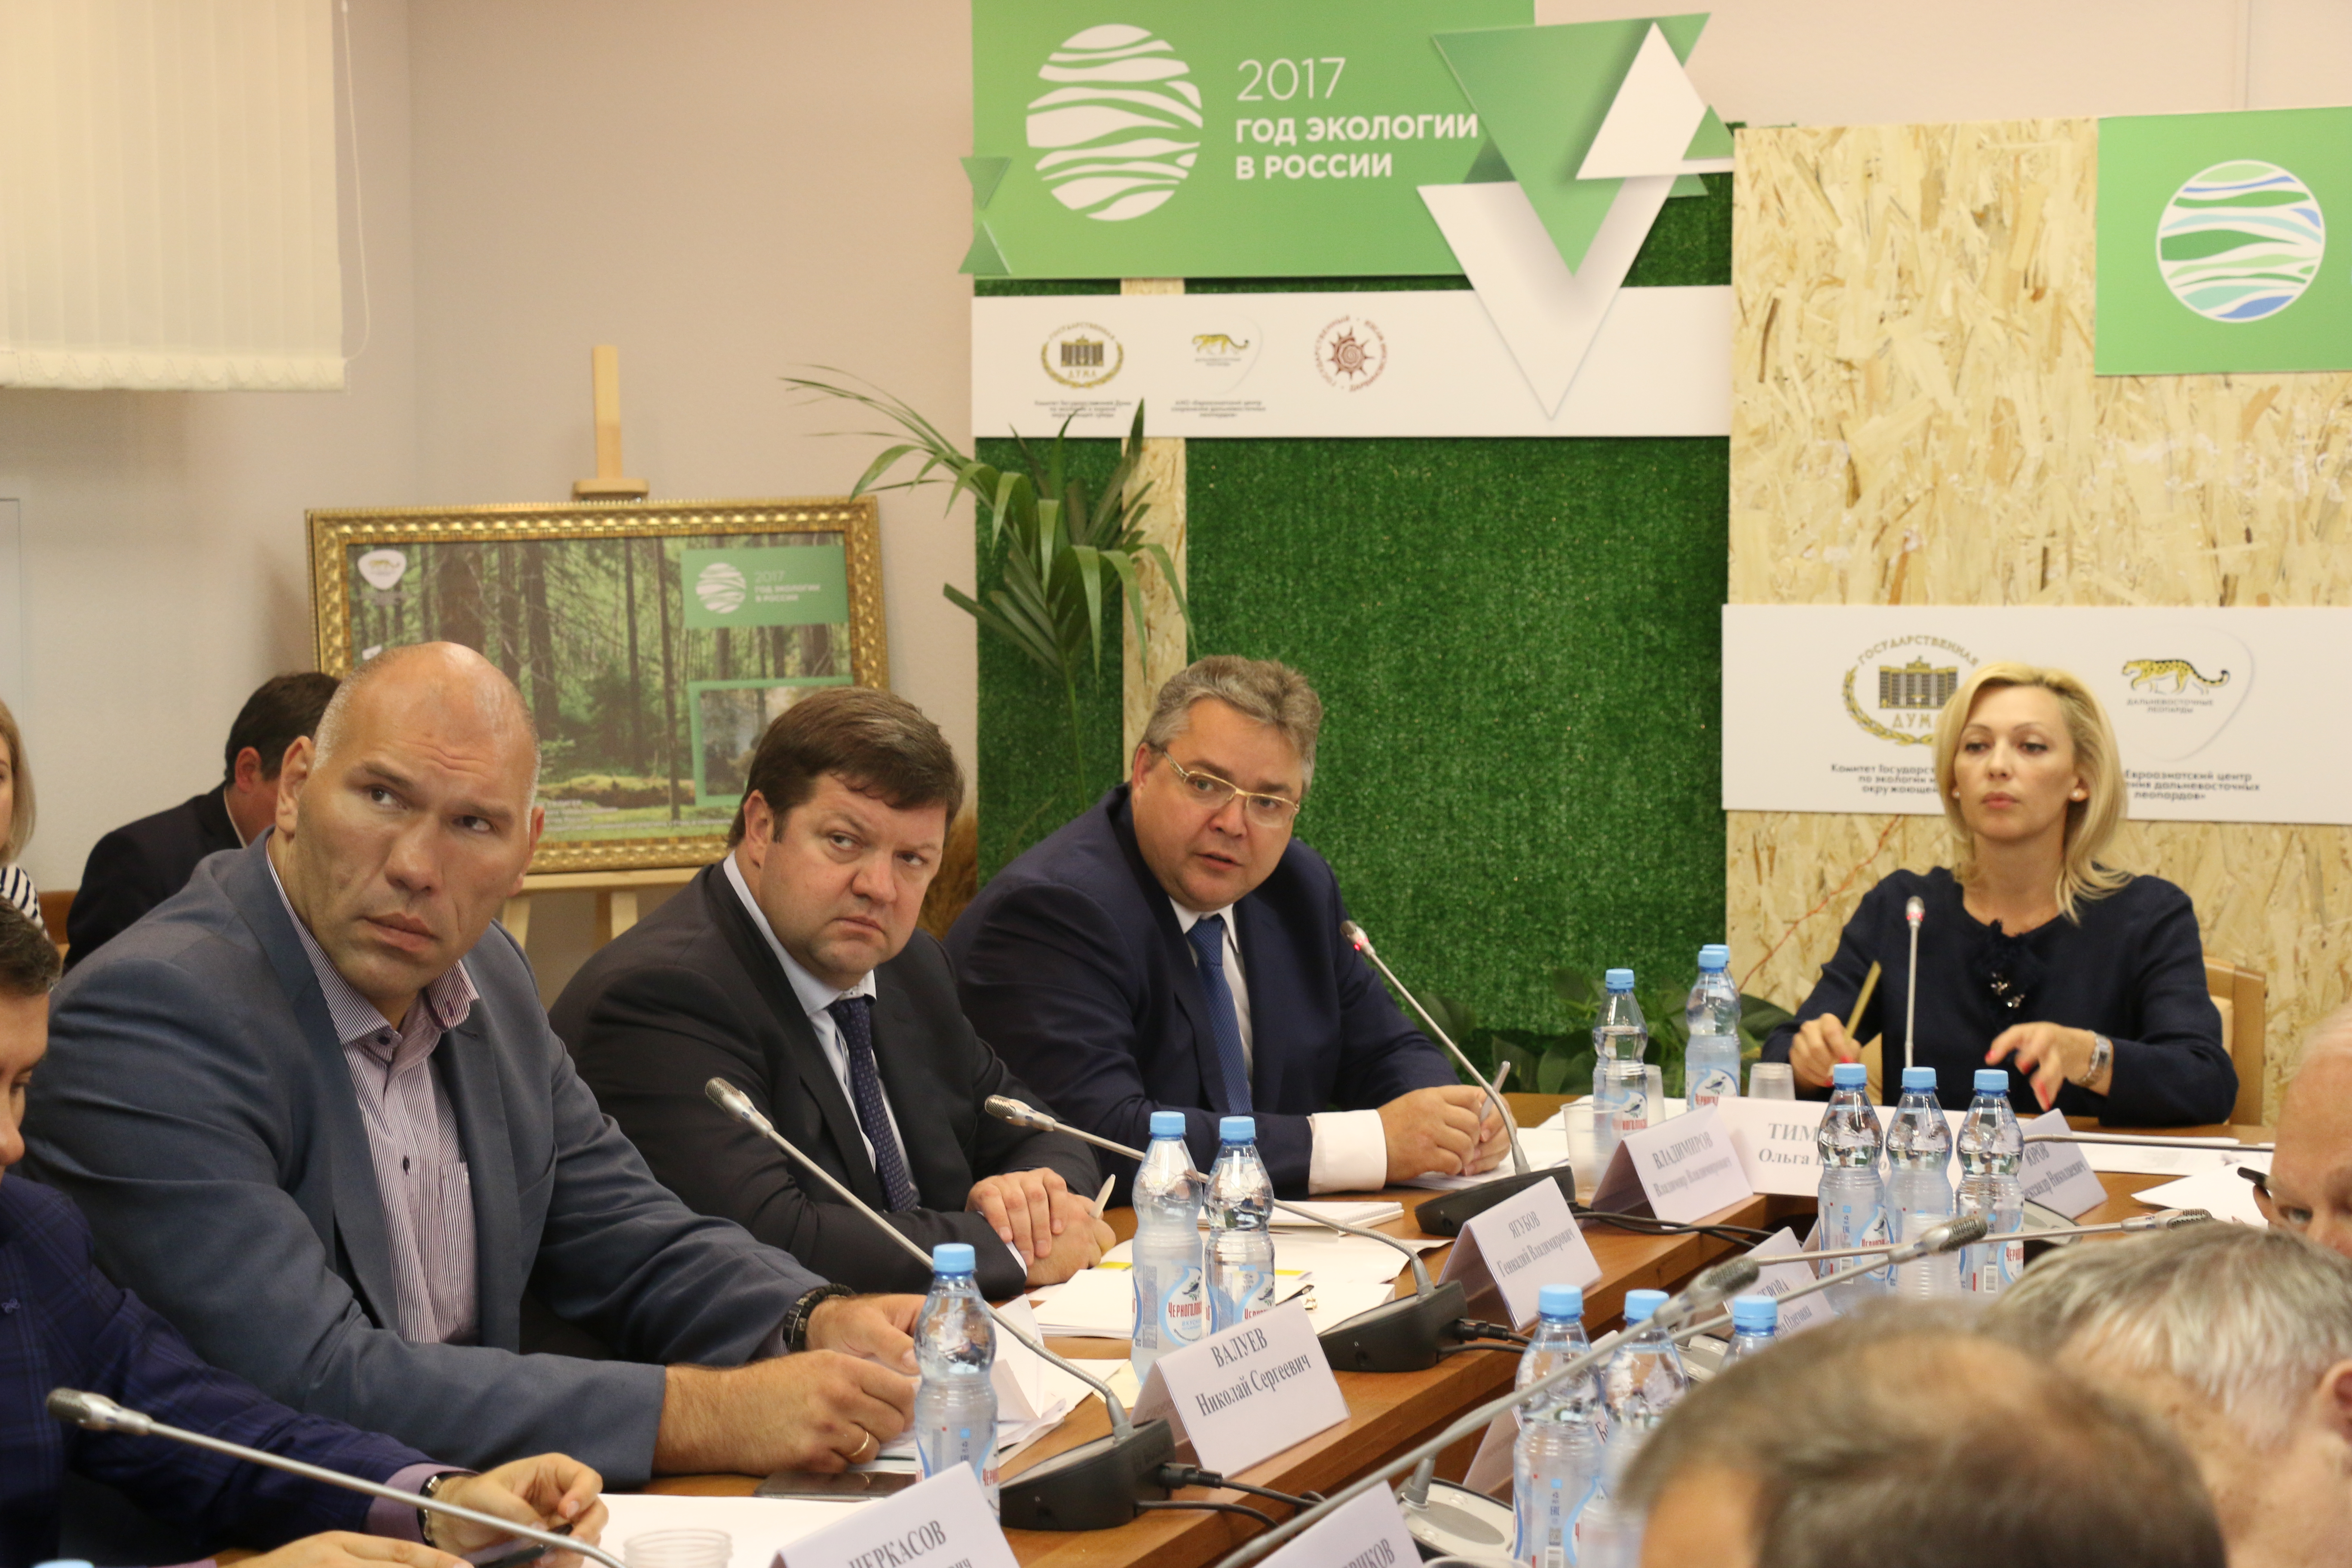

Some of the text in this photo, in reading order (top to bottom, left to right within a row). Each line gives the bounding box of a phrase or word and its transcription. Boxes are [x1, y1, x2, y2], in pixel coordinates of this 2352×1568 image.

[1237, 57, 1346, 101] 2017
[1236, 113, 1479, 146] ГОД ЭКОЛОГИИ
[1236, 153, 1393, 179] В РОССИИ
[1858, 634, 1979, 667] ГОСУДАРСТВЕННАЯ
[1893, 713, 1935, 729] ДУМ
[1831, 764, 1936, 777] Комитет Государст
[2217, 773, 2252, 782] центр
[2154, 782, 2260, 791] дальневосточных
[1768, 1123, 1820, 1142] ТИМ
[1652, 1131, 1714, 1170] ВЛАДИМИРОВ
[1758, 1148, 1810, 1165] Ольга
[1508, 1210, 1540, 1239] ЯГУБОВ
[1496, 1228, 1575, 1278] Геннадий Владимирович
[1210, 1327, 1268, 1368] ВАЛУЕВ
[1194, 1376, 1253, 1417] Николай
[1250, 1354, 1312, 1392] Сергеевич
